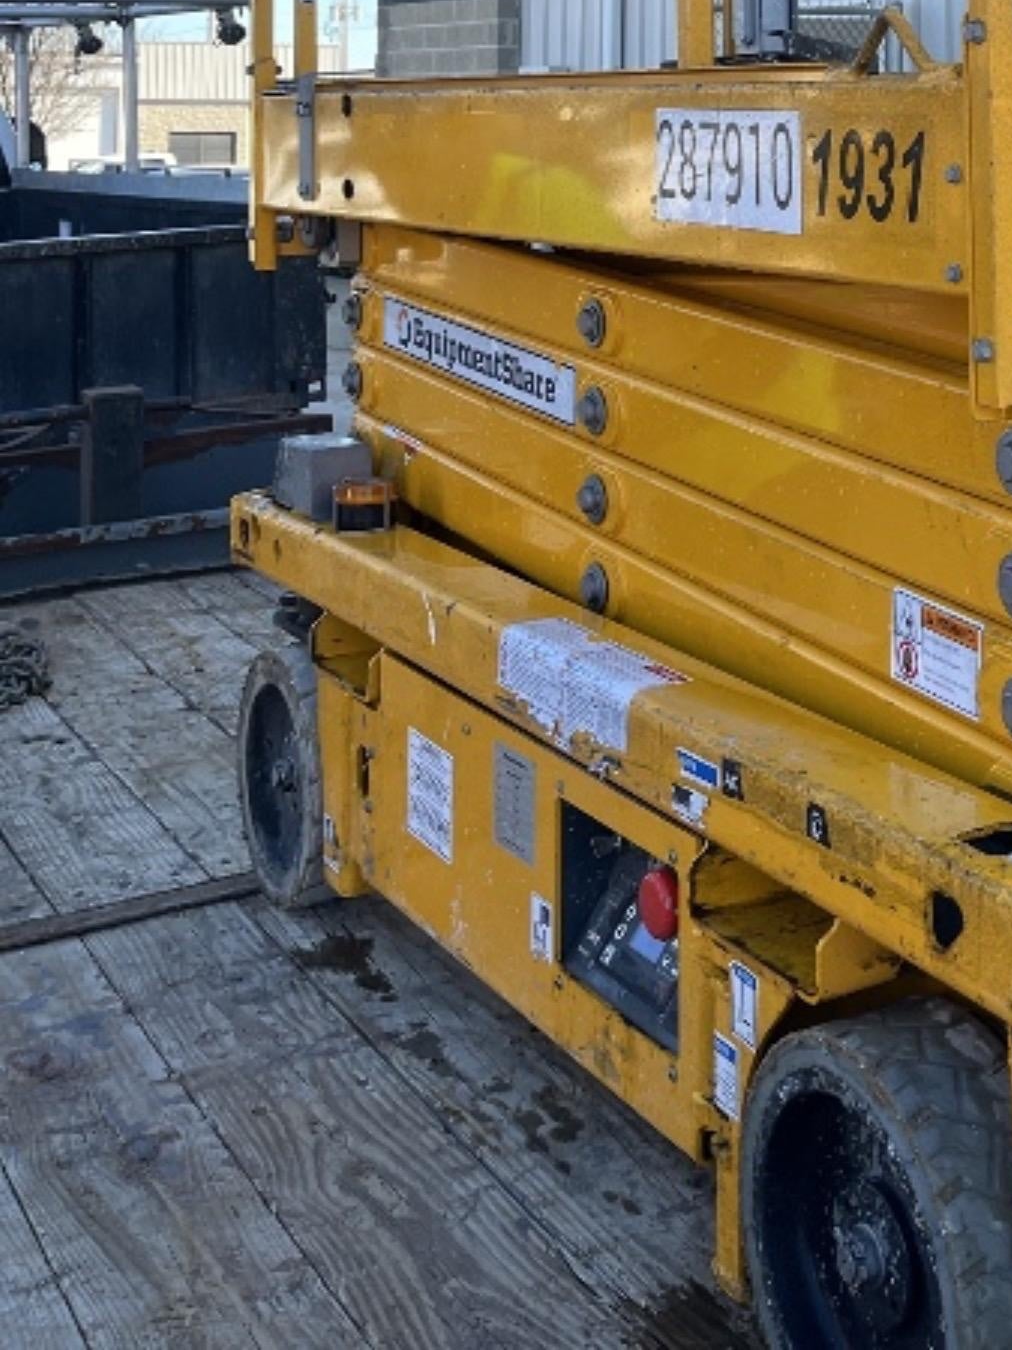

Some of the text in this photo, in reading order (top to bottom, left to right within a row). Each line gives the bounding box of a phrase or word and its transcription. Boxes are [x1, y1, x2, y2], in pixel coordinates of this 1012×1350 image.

[656, 119, 793, 210] 287910
[812, 129, 925, 222] 1931
[413, 317, 556, 402] EquipmentShare
